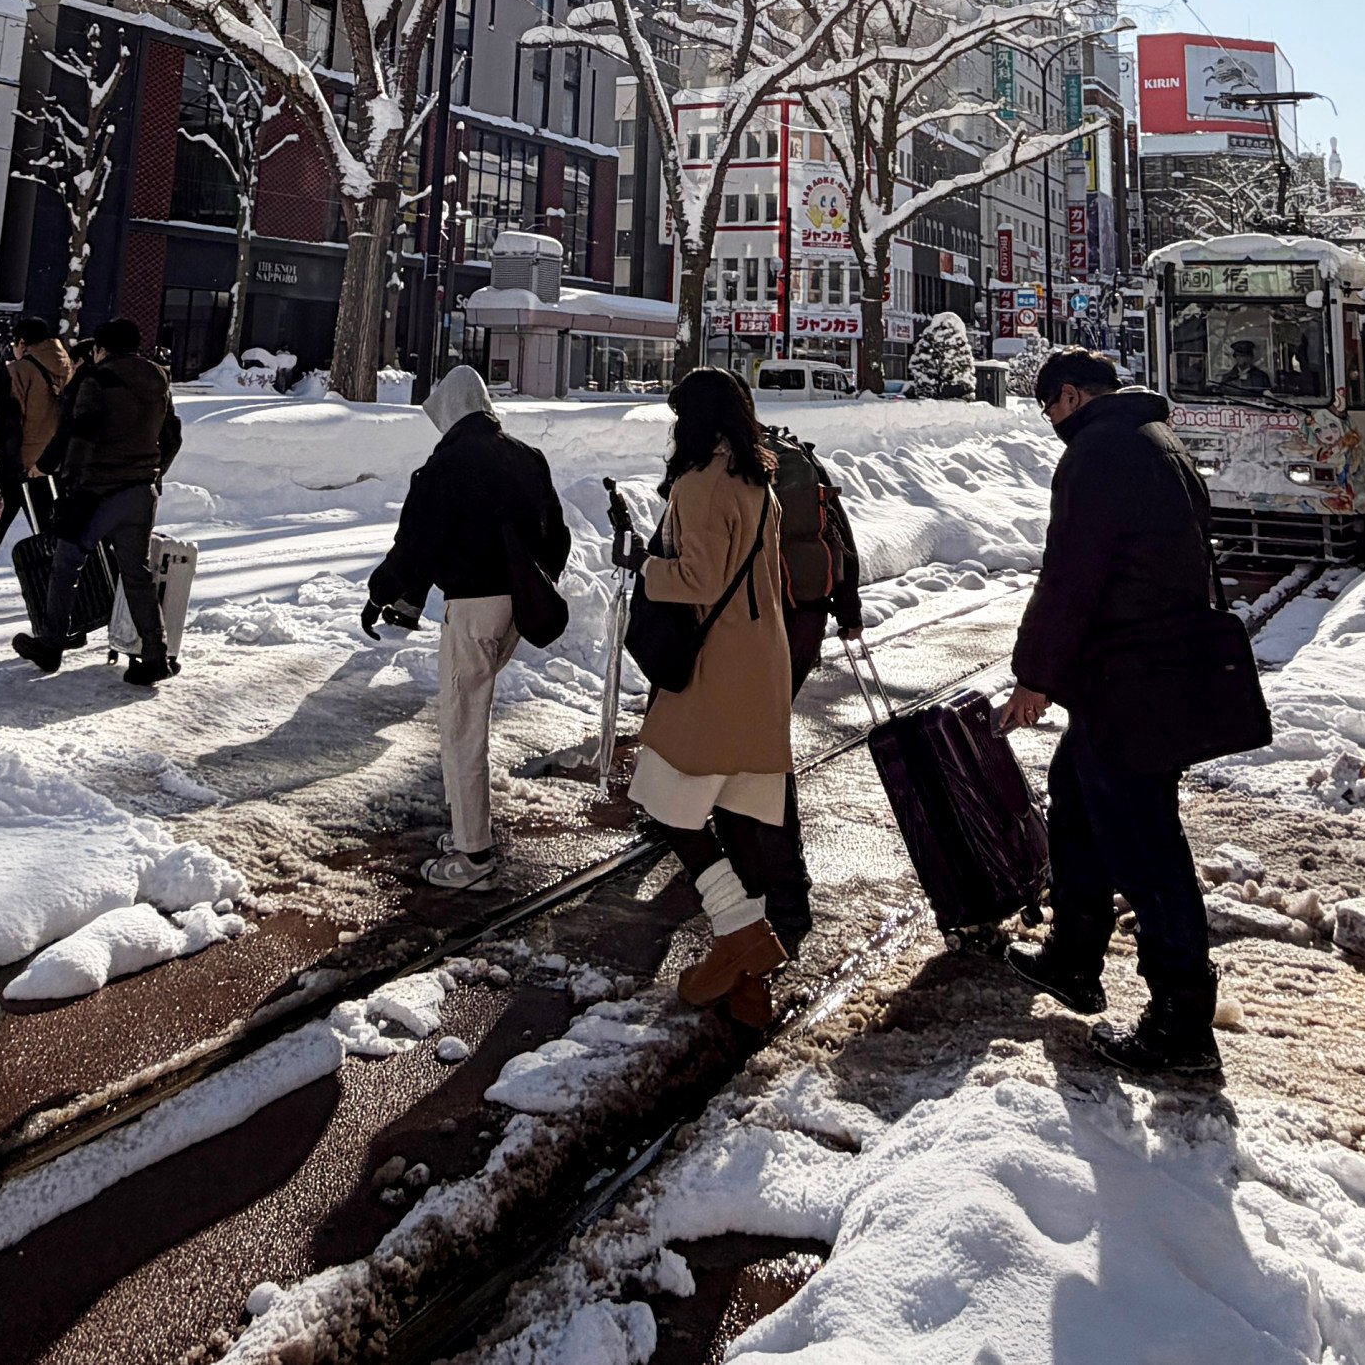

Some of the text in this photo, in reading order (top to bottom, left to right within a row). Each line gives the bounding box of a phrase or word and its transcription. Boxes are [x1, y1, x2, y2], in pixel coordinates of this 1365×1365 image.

[1144, 78, 1180, 89] KIRIN
[796, 317, 859, 333] ジャンカラ
